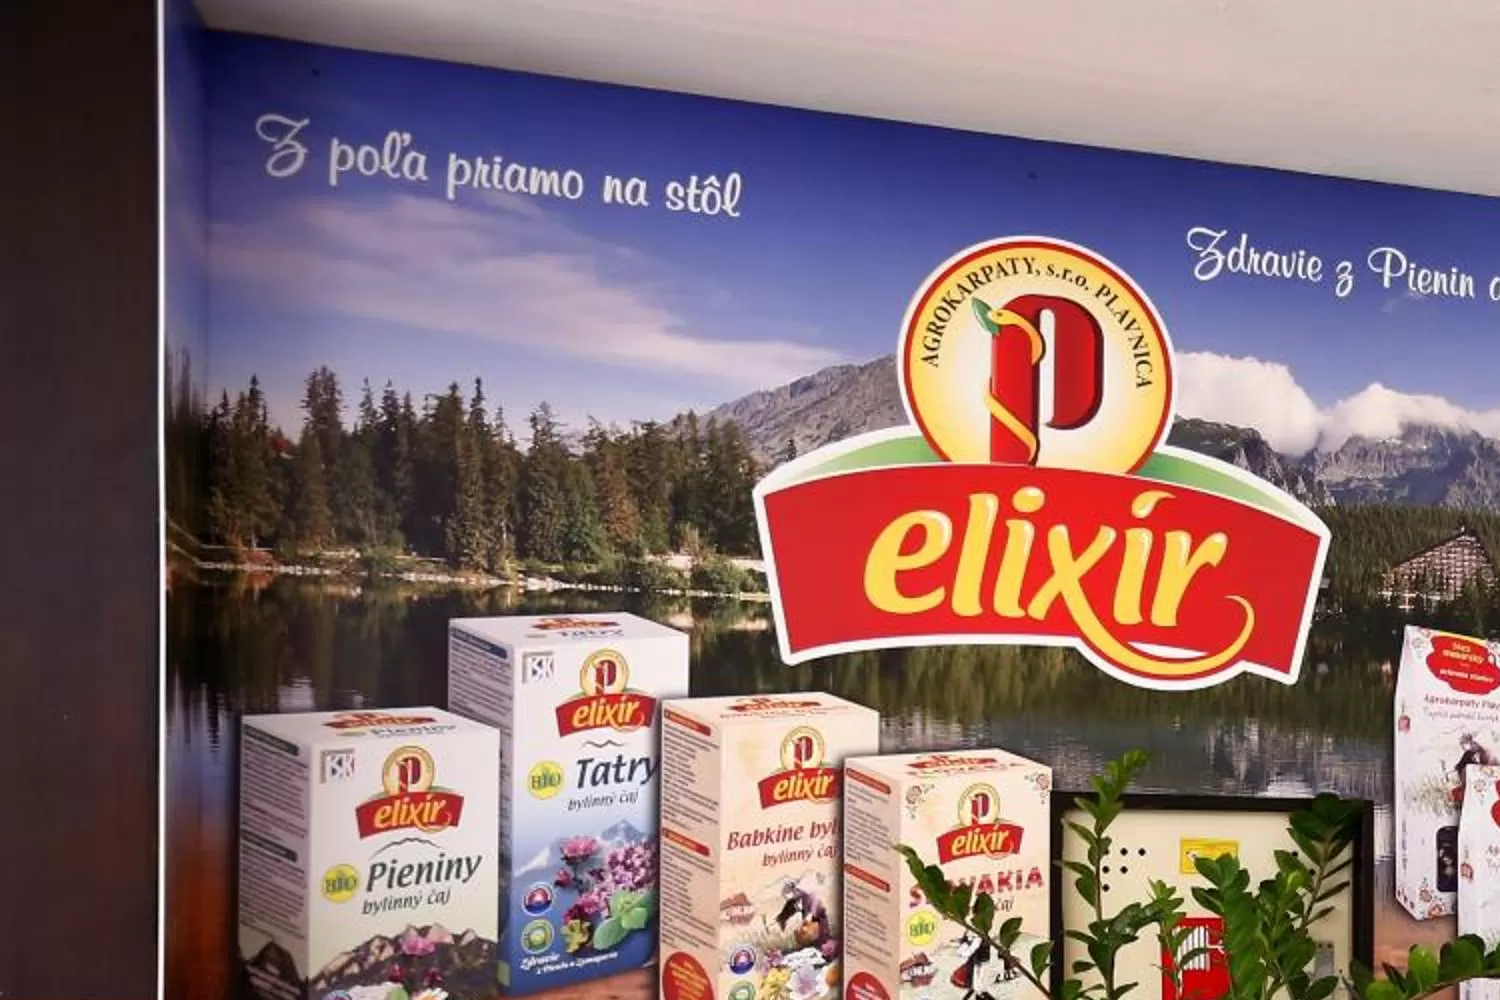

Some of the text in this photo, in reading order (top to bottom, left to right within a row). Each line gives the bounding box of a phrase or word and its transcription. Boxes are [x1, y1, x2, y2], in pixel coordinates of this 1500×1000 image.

[255, 113, 743, 217] Z poľa priamo na stôl
[1186, 226, 1323, 282] Zdravie
[1335, 260, 1354, 297] z
[1367, 246, 1475, 299] Pienin
[921, 256, 1152, 389] AGROKARPATY, s.r.o. PLAVNICA
[863, 486, 1256, 676] elixír
[577, 754, 661, 790] Tatry
[727, 824, 804, 851] Babkine
[366, 852, 482, 892] Pieniny
[362, 893, 423, 915] bylinný
